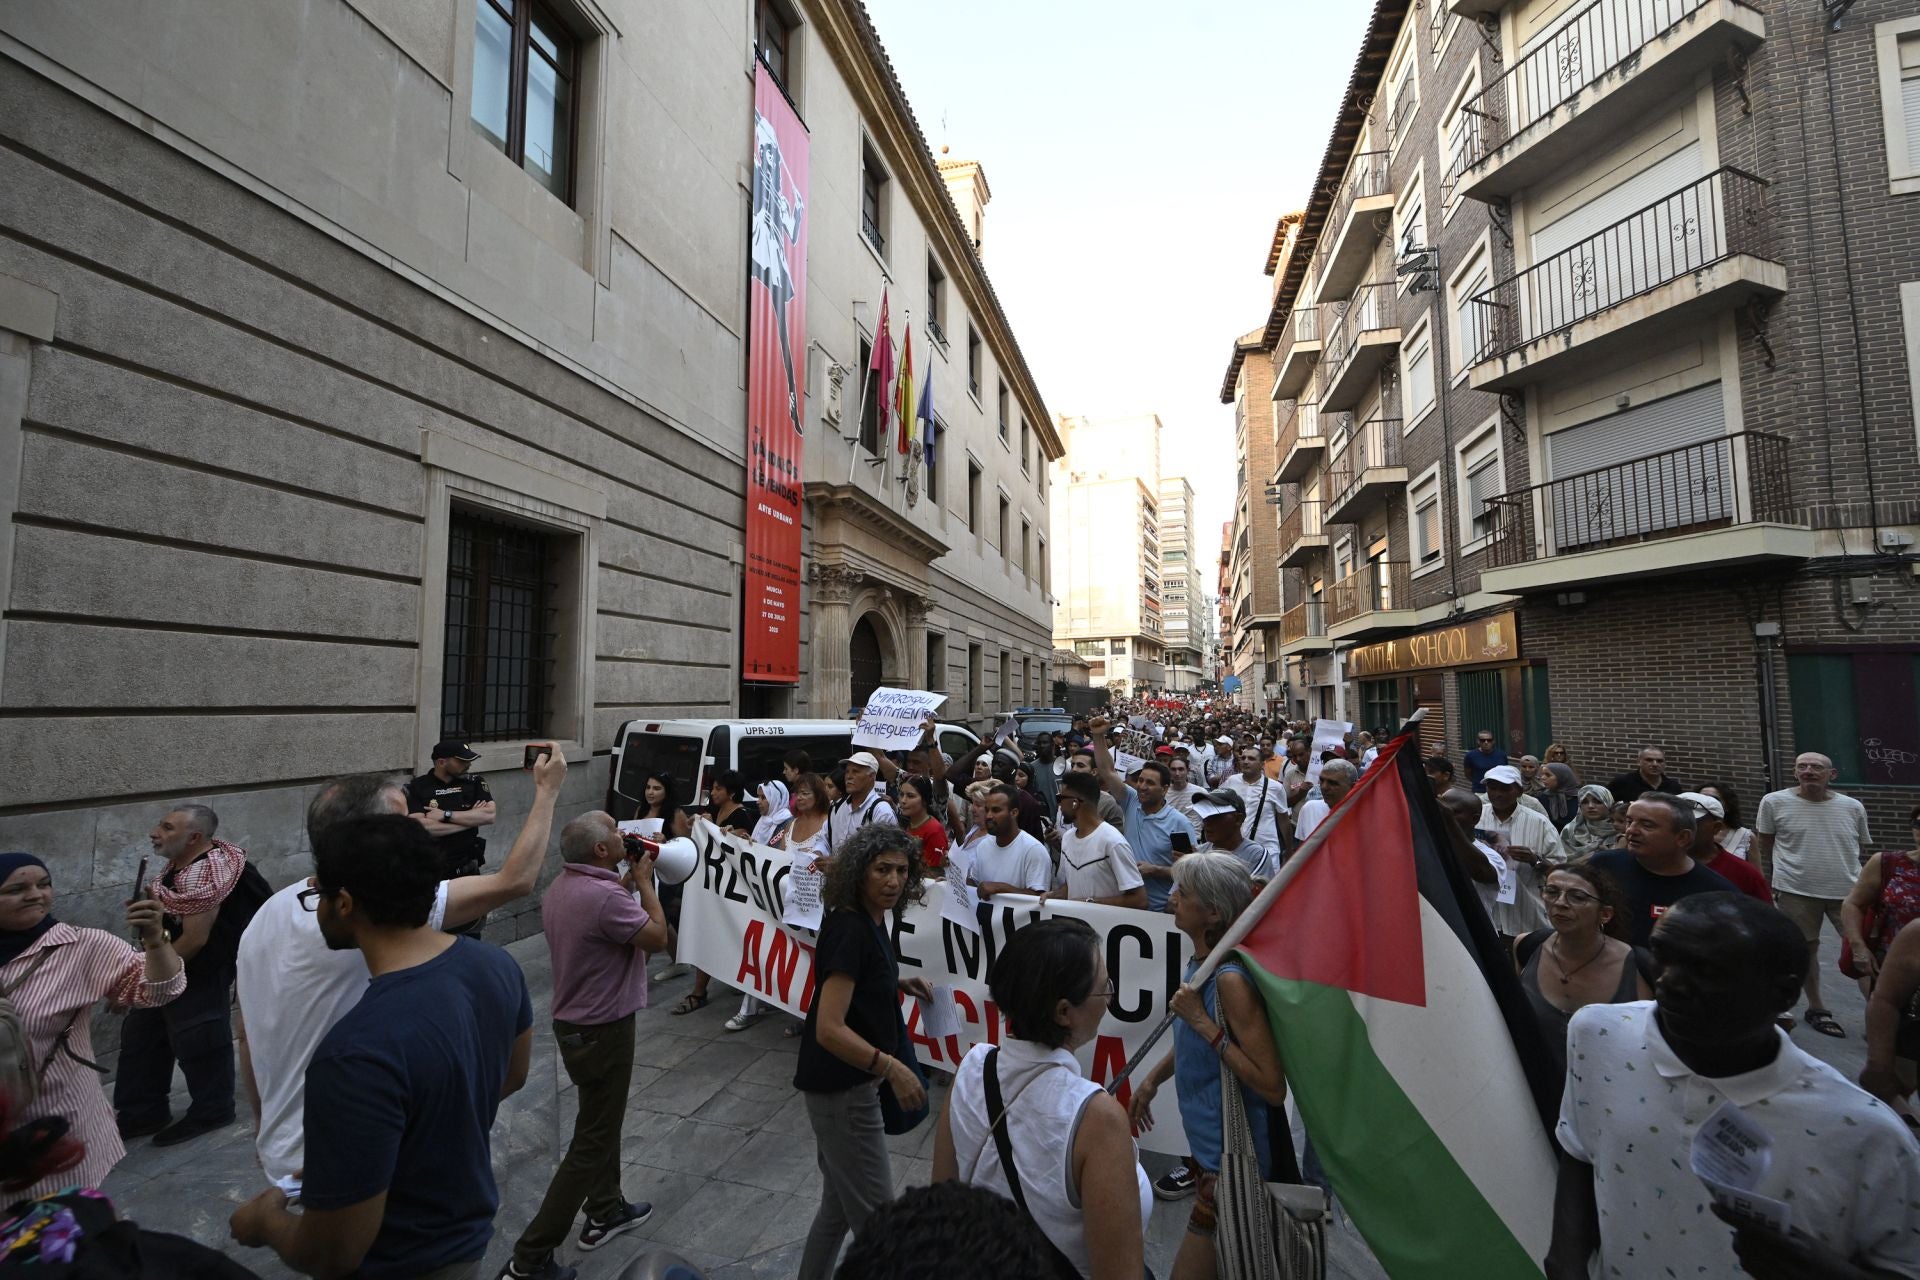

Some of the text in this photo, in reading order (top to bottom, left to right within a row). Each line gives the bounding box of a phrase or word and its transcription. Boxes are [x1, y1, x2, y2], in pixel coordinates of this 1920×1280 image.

[758, 502, 793, 526] ARTE URBANO
[766, 585, 783, 595] MURCIA
[773, 600, 785, 609] MAYO
[1361, 627, 1473, 673] INITIAL SCHOOL
[745, 726, 785, 735] UPR-37B
[857, 719, 920, 738] PACHEQUERO
[943, 902, 1182, 1023] MCI
